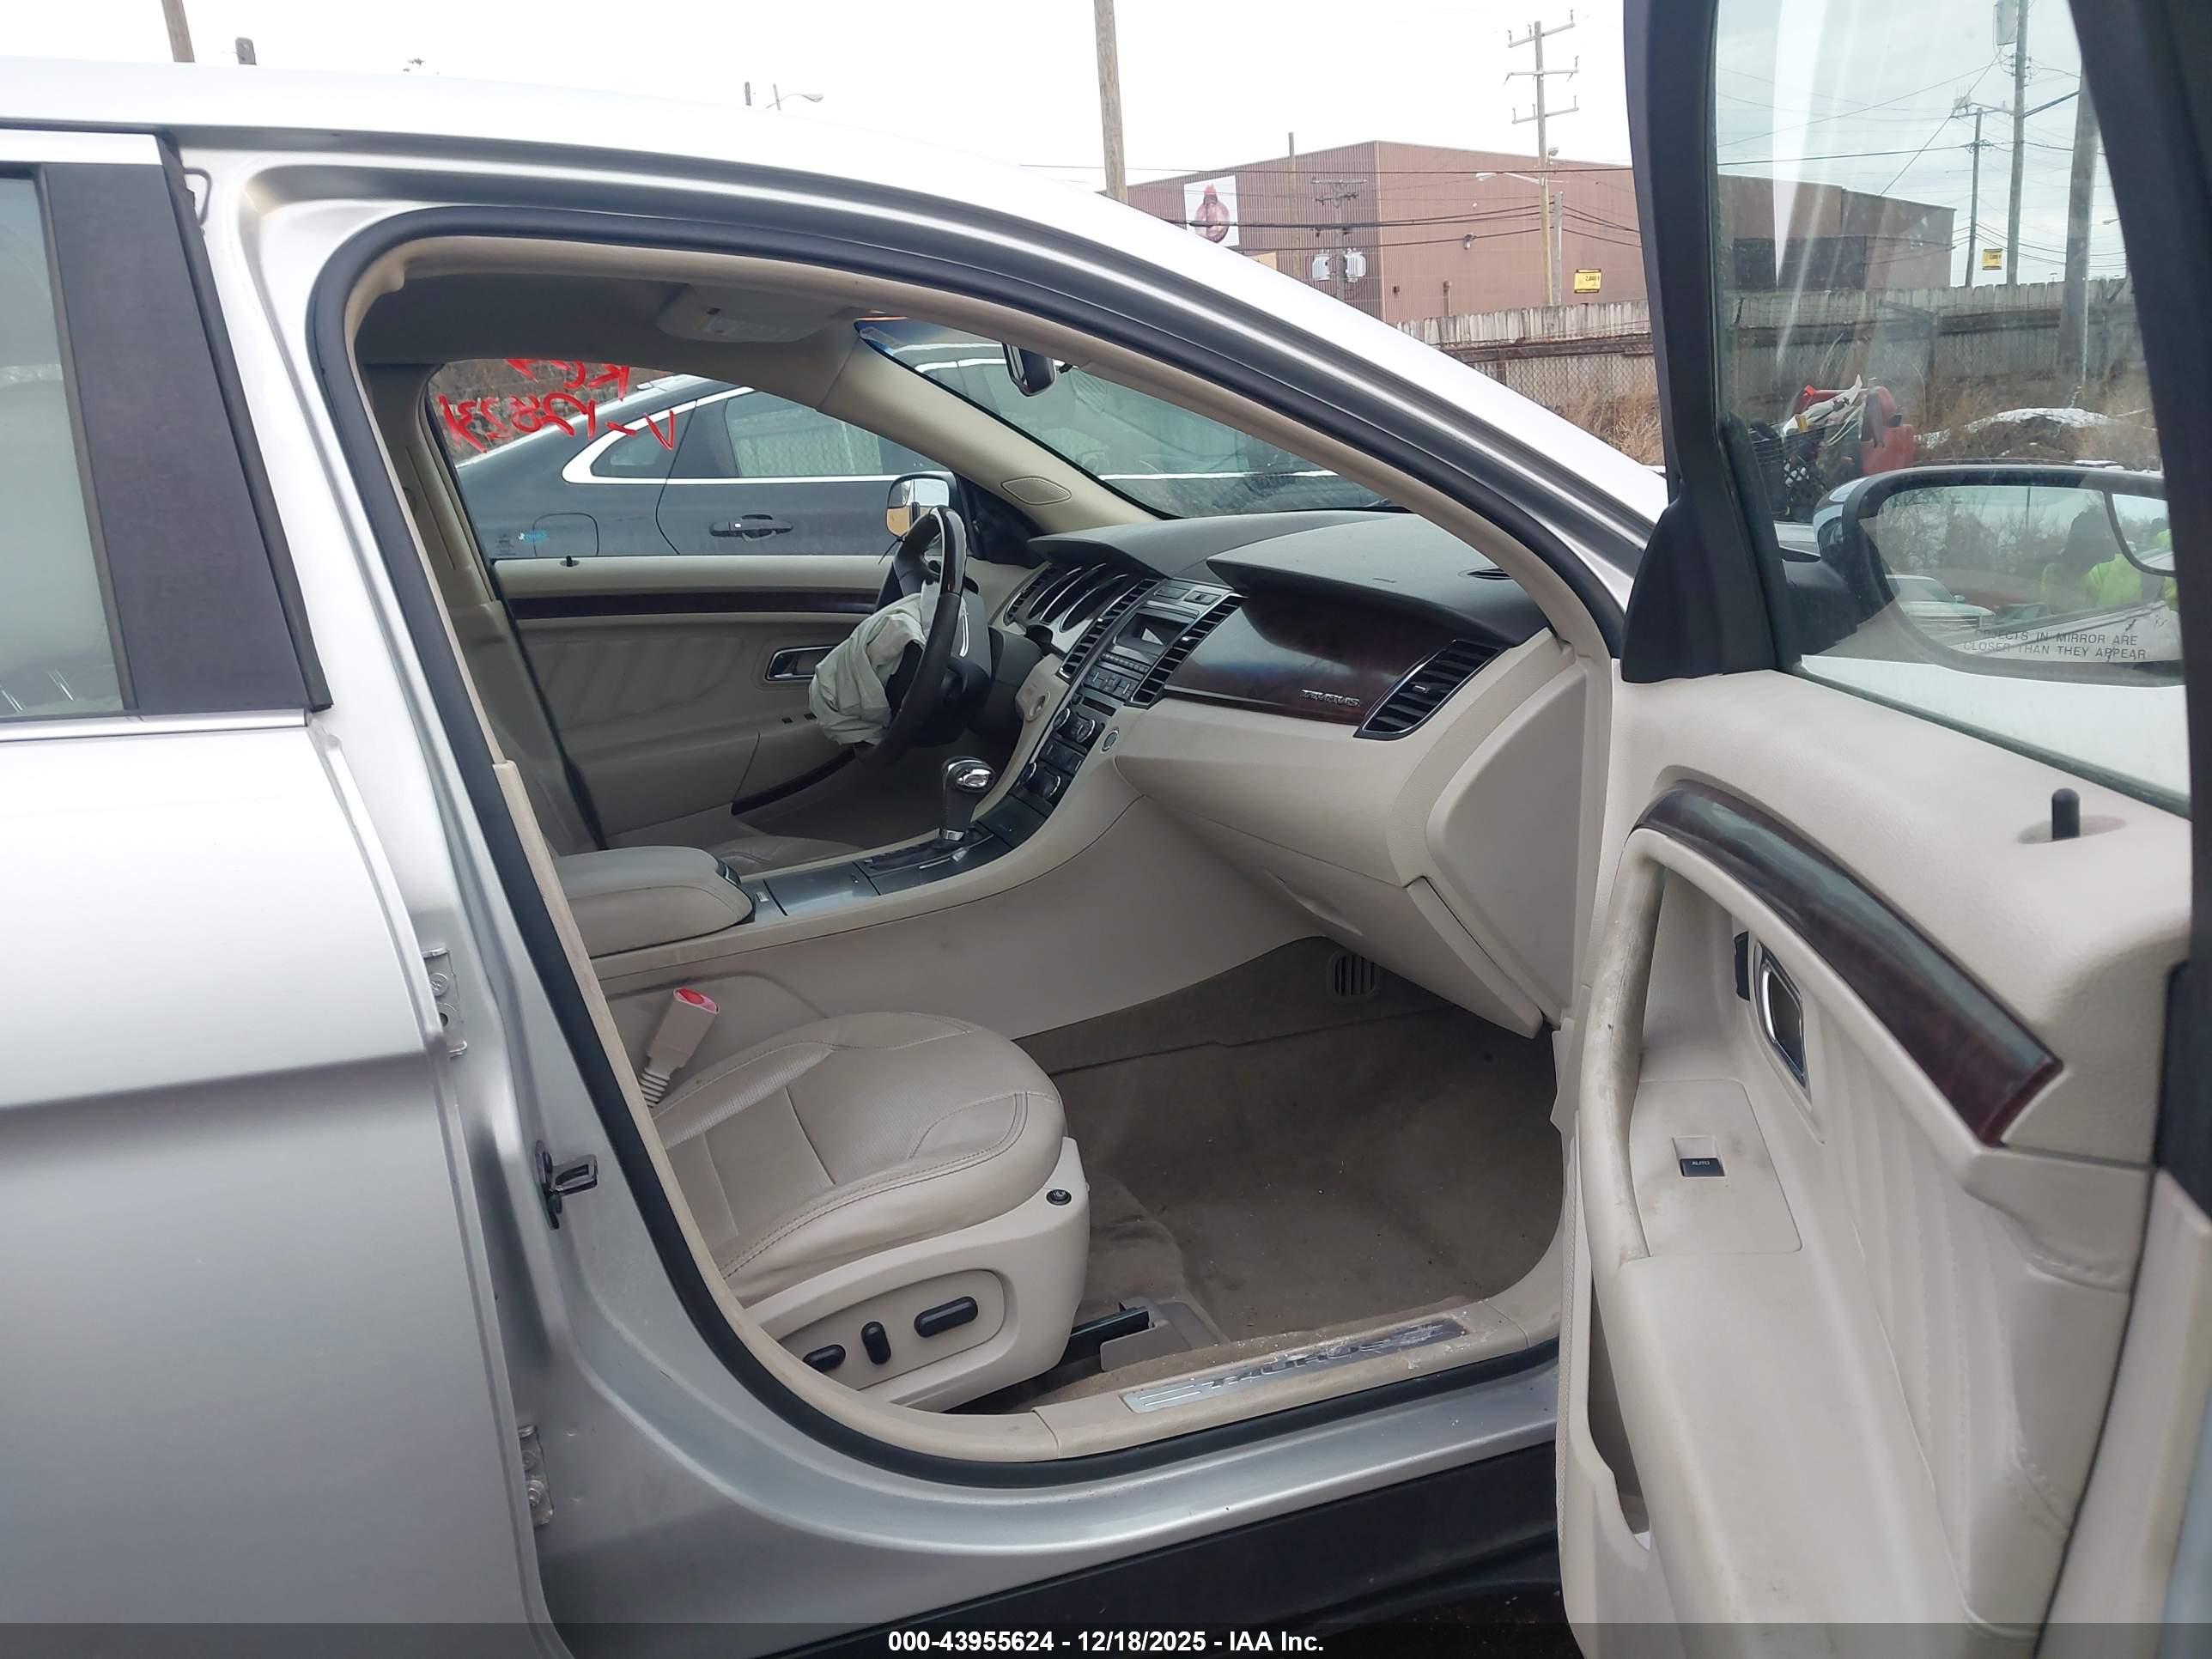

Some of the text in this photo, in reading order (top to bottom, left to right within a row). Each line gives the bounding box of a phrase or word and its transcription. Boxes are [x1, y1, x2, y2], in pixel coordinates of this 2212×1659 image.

[2037, 632, 2049, 641] IN
[2057, 633, 2106, 644] MIRROR
[2112, 635, 2137, 646] ARE
[1964, 641, 2146, 659] CLOSER THAN THEY APPEAR
